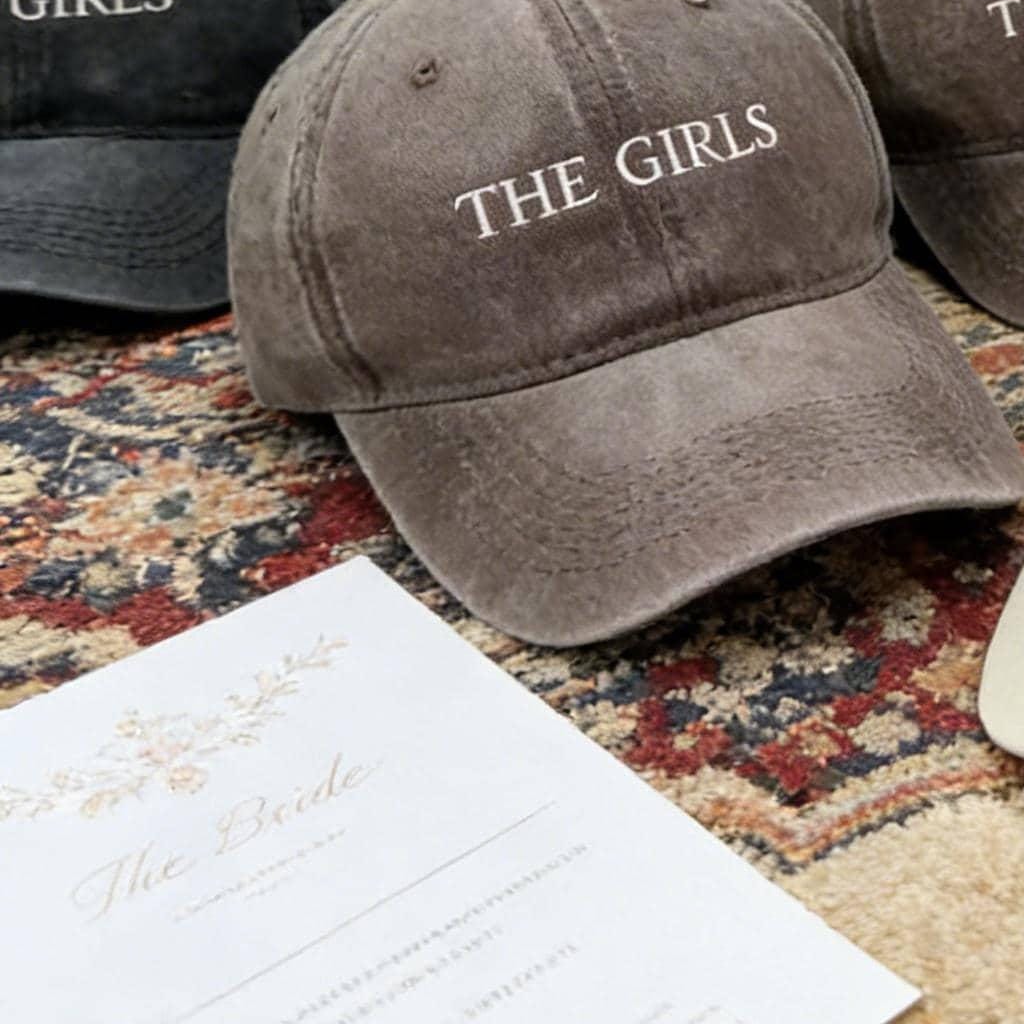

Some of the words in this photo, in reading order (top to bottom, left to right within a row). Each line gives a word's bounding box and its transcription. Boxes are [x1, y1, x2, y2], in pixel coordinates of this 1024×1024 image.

[454, 155, 600, 240] THE
[615, 103, 778, 186] GIRLS
[71, 840, 198, 924] The
[214, 752, 378, 857] Bride
